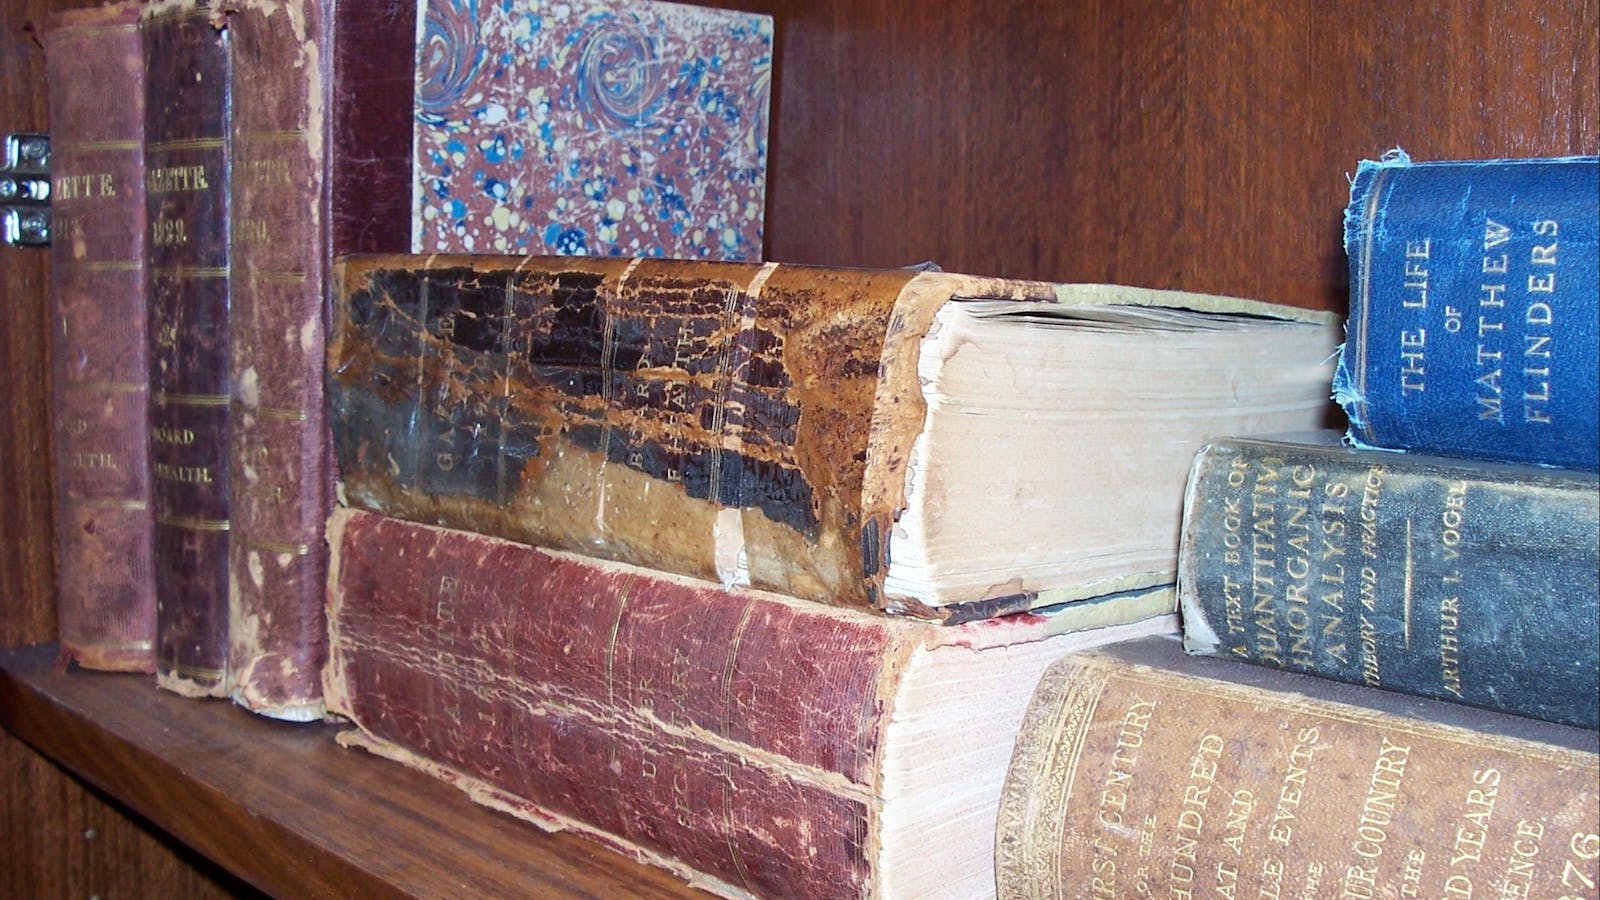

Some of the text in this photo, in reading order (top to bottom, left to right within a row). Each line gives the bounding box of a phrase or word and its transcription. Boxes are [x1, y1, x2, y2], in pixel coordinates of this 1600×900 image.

[1401, 237, 1430, 396] THE LIFE
[1445, 306, 1462, 333] OF
[1475, 218, 1511, 423] MATTHEW
[1524, 218, 1559, 424] FLINDERS
[1224, 497, 1241, 566] BOOK
[1286, 464, 1316, 667] INORGANIC
[1442, 480, 1467, 561] VOGEL
[1224, 575, 1246, 634] TEXT
[1321, 482, 1348, 665] ANALYSIS
[1361, 566, 1377, 612] AND
[1232, 644, 1249, 659] A
[1441, 596, 1464, 698] ARTHUR
[1100, 694, 1157, 826] CENTURY
[1269, 726, 1320, 846] EVENTS
[1353, 737, 1410, 858] COUNTRY
[1139, 814, 1157, 857] THE
[1224, 789, 1255, 856] AND
[1451, 767, 1502, 866] YEARS
[1401, 849, 1425, 898] THE
[1559, 832, 1599, 900] 76
